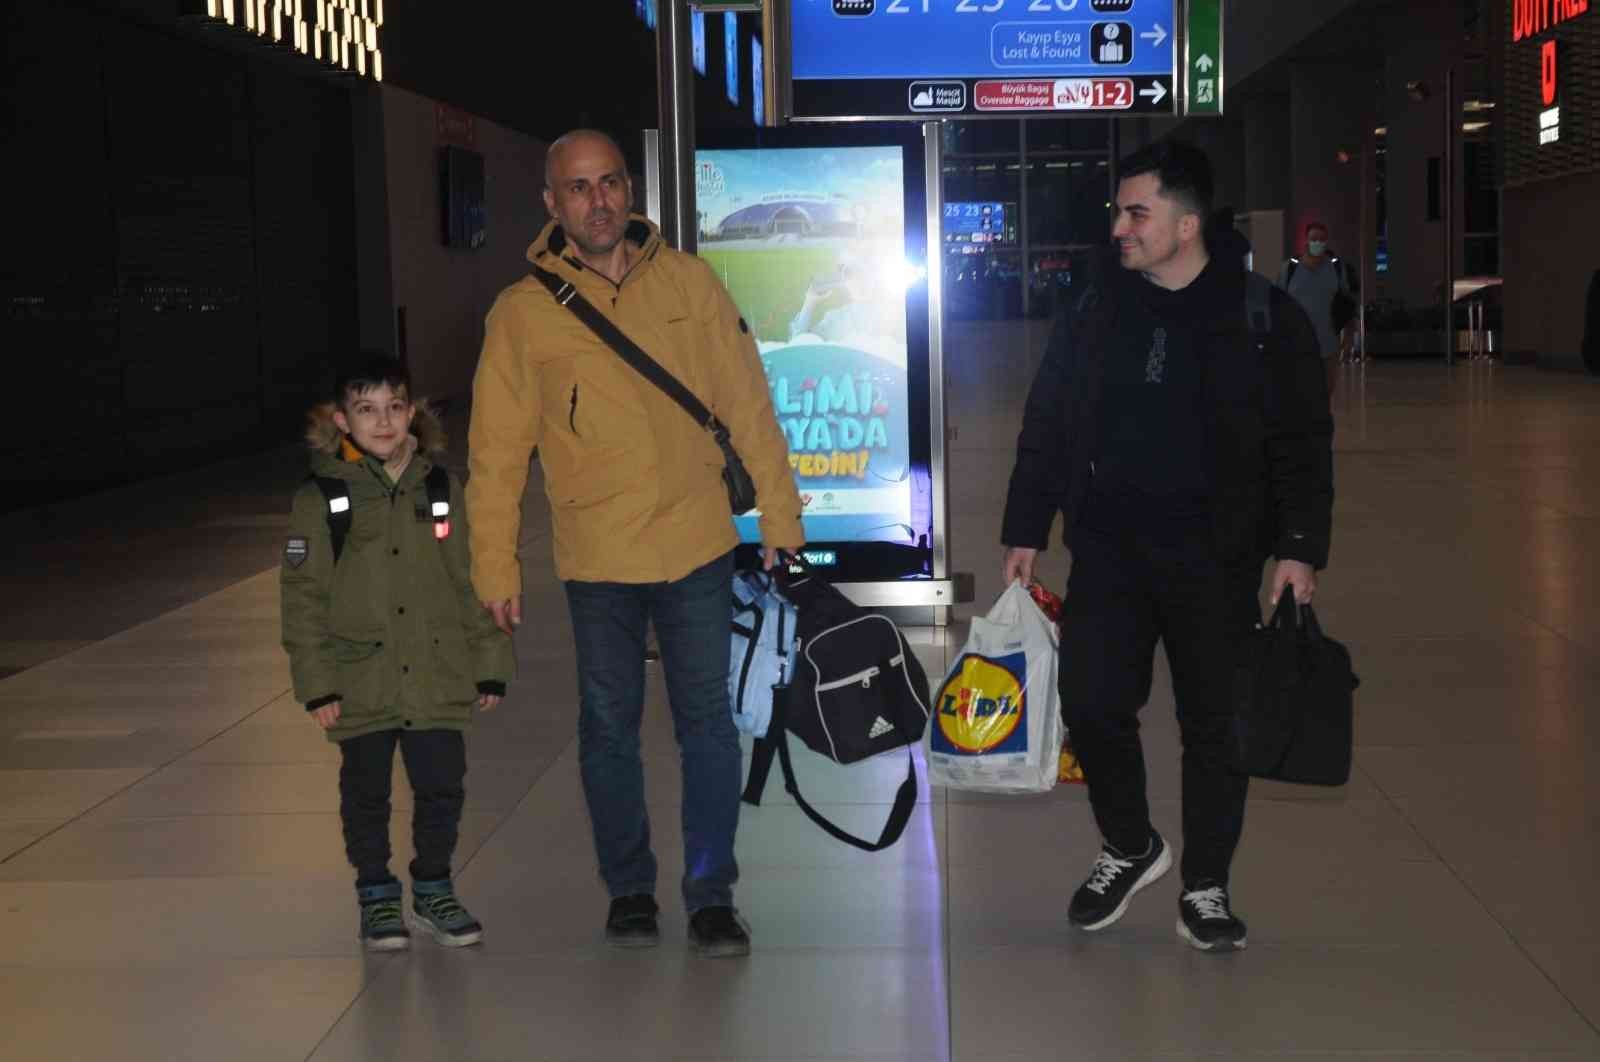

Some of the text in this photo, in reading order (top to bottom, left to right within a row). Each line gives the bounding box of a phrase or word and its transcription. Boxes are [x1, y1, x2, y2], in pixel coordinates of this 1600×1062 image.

[1002, 45, 1081, 59] Lost & Found
[1095, 82, 1127, 106] 1-2
